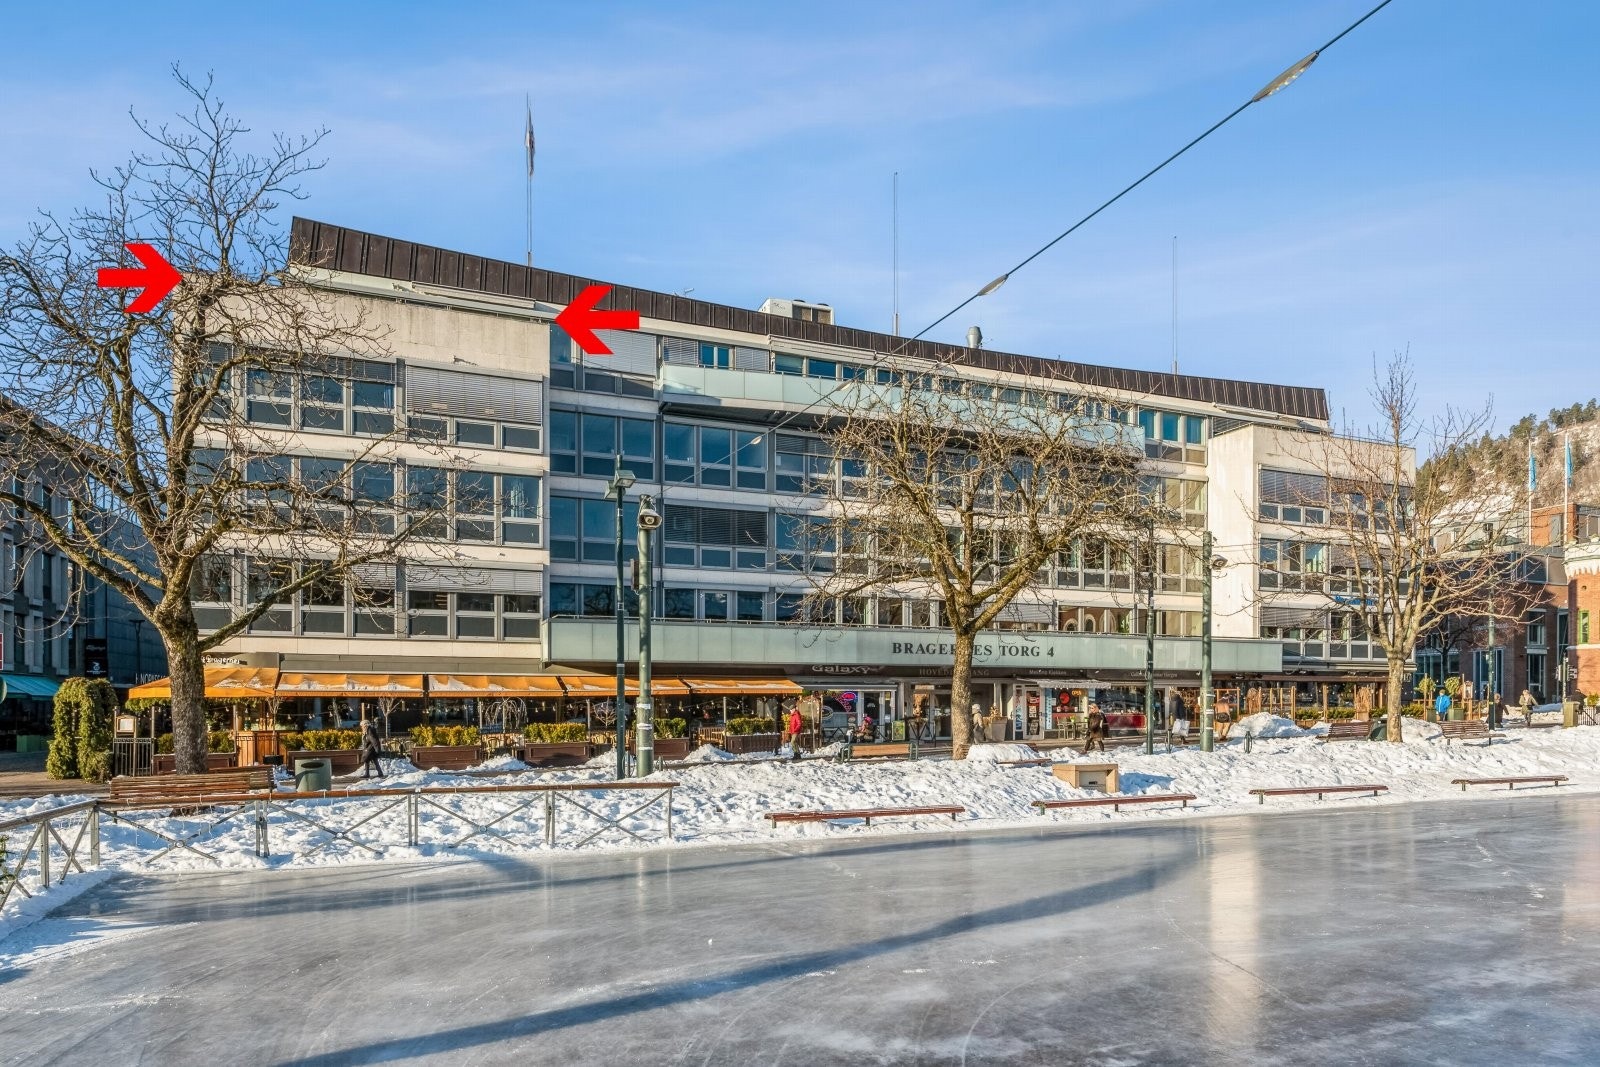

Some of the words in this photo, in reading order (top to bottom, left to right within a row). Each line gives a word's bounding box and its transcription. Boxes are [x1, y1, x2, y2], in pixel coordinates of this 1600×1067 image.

[892, 642, 992, 656] BRAGEES
[999, 645, 1040, 657] TORG
[1047, 647, 1055, 657] 4
[812, 664, 870, 675] Galaxy
